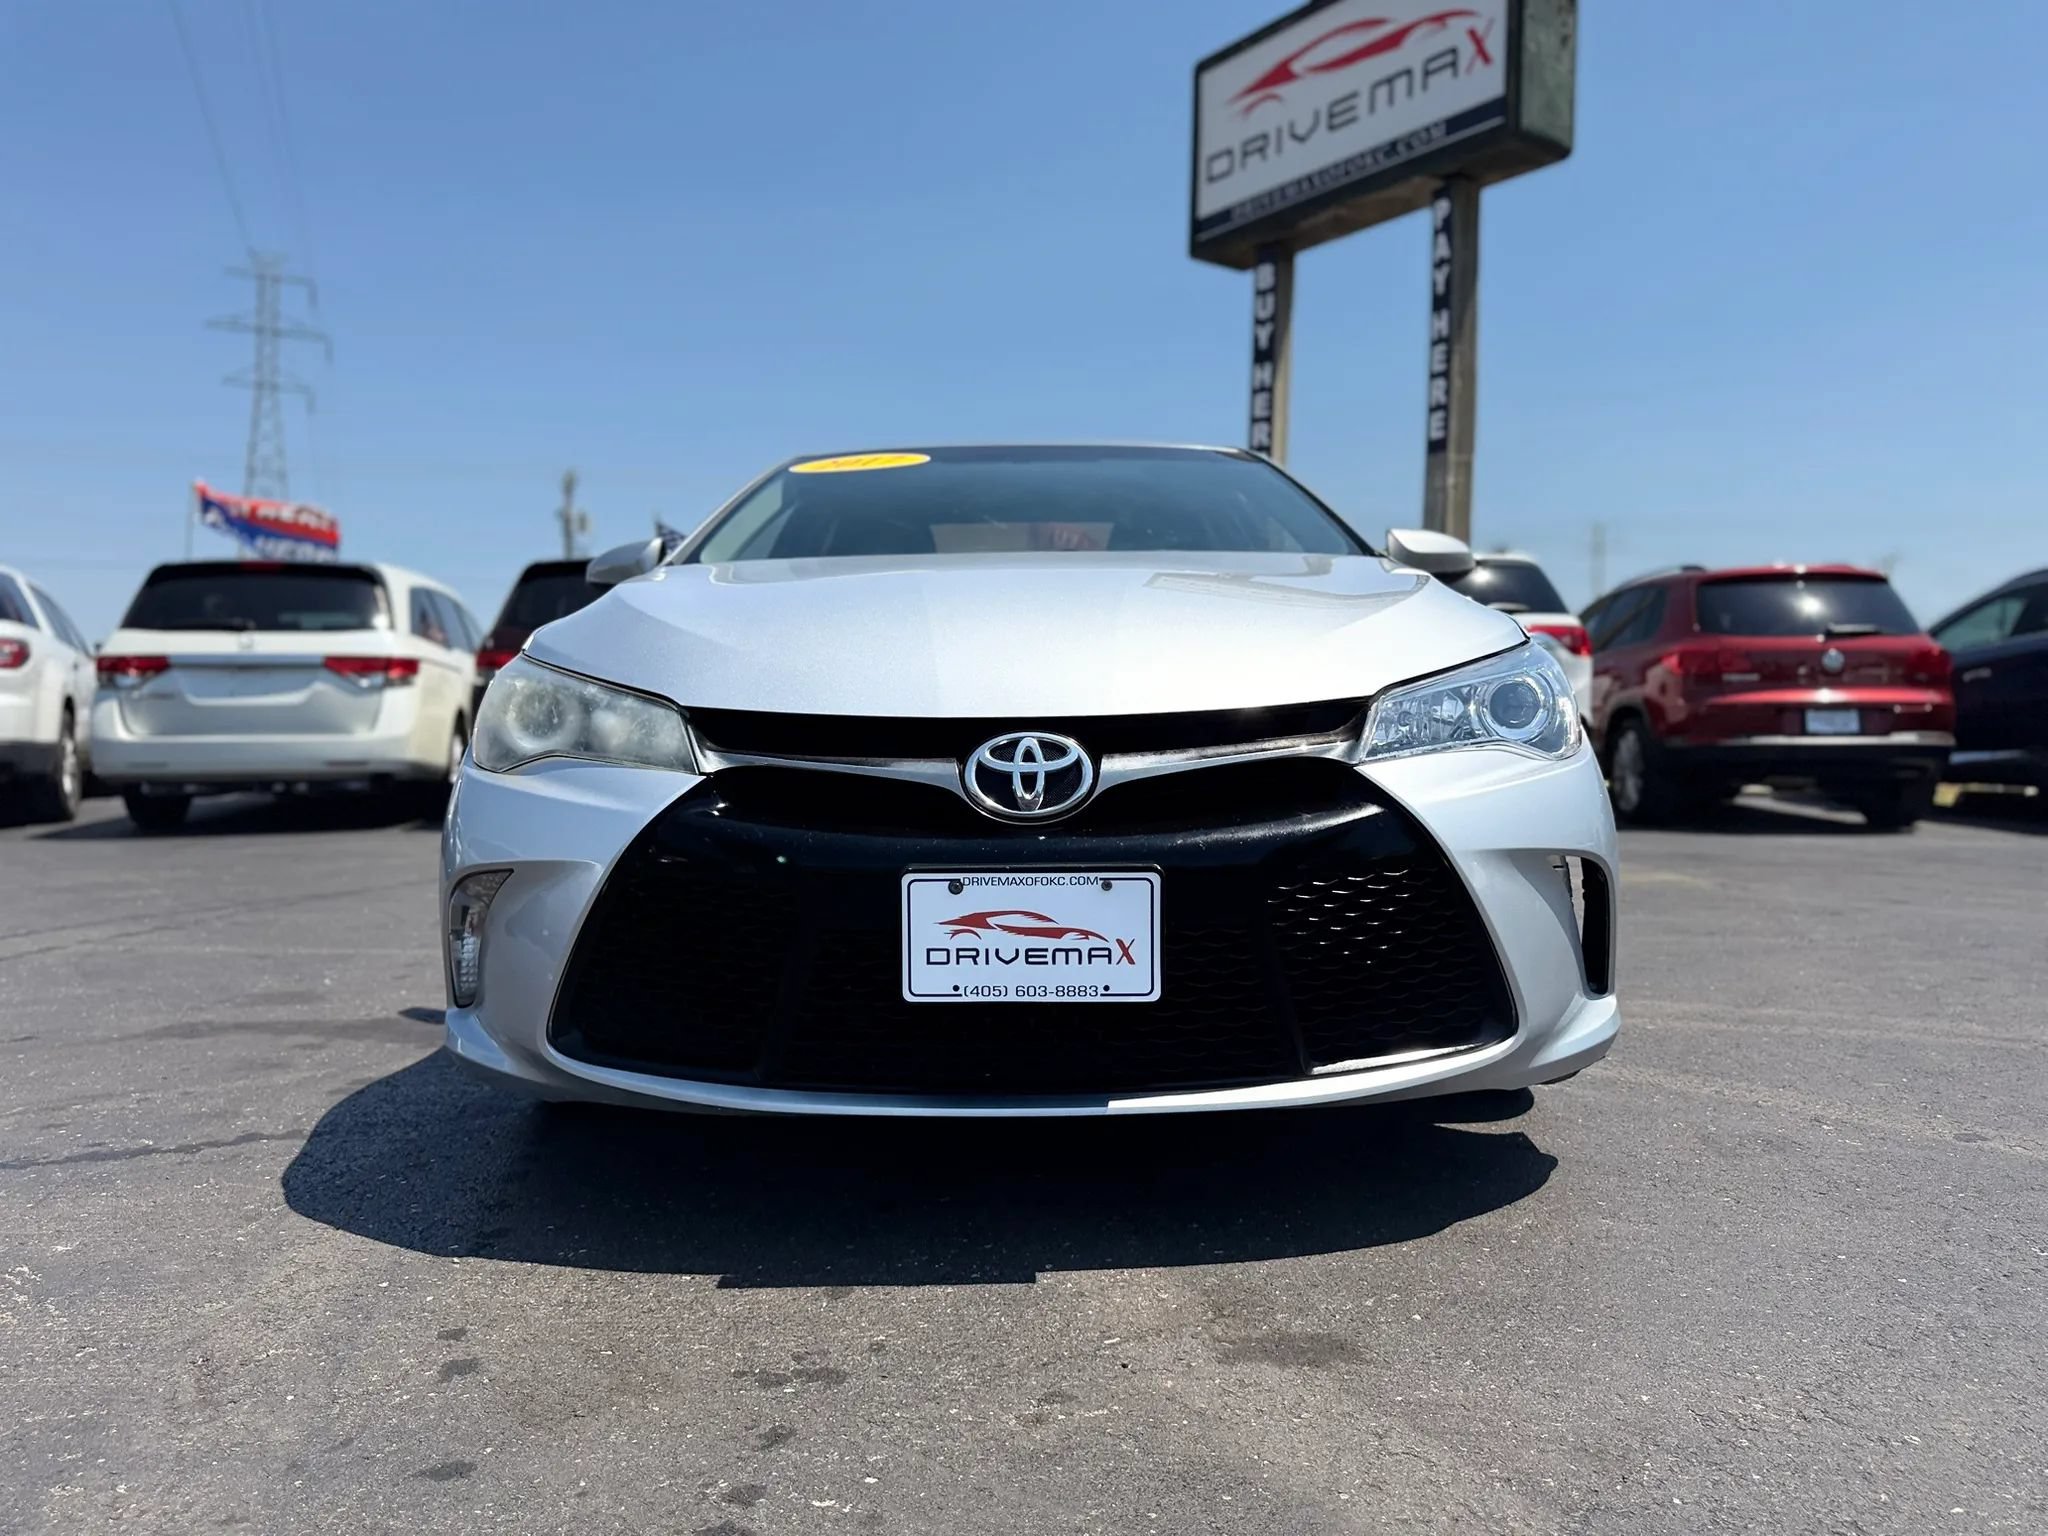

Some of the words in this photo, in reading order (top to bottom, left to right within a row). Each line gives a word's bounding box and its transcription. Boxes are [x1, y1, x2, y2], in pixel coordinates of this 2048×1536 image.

[1206, 18, 1496, 185] DRIVEMAX
[1434, 196, 1451, 296] PAY
[1255, 262, 1275, 350] BUY
[1252, 361, 1272, 449] HER
[1430, 308, 1449, 440] HERE
[962, 876, 1099, 887] DRIVEMAXOFOKC.COM
[926, 938, 1136, 966] DRIVEMAX
[963, 985, 1008, 998] (405)
[1015, 985, 1099, 998] 603-8883
